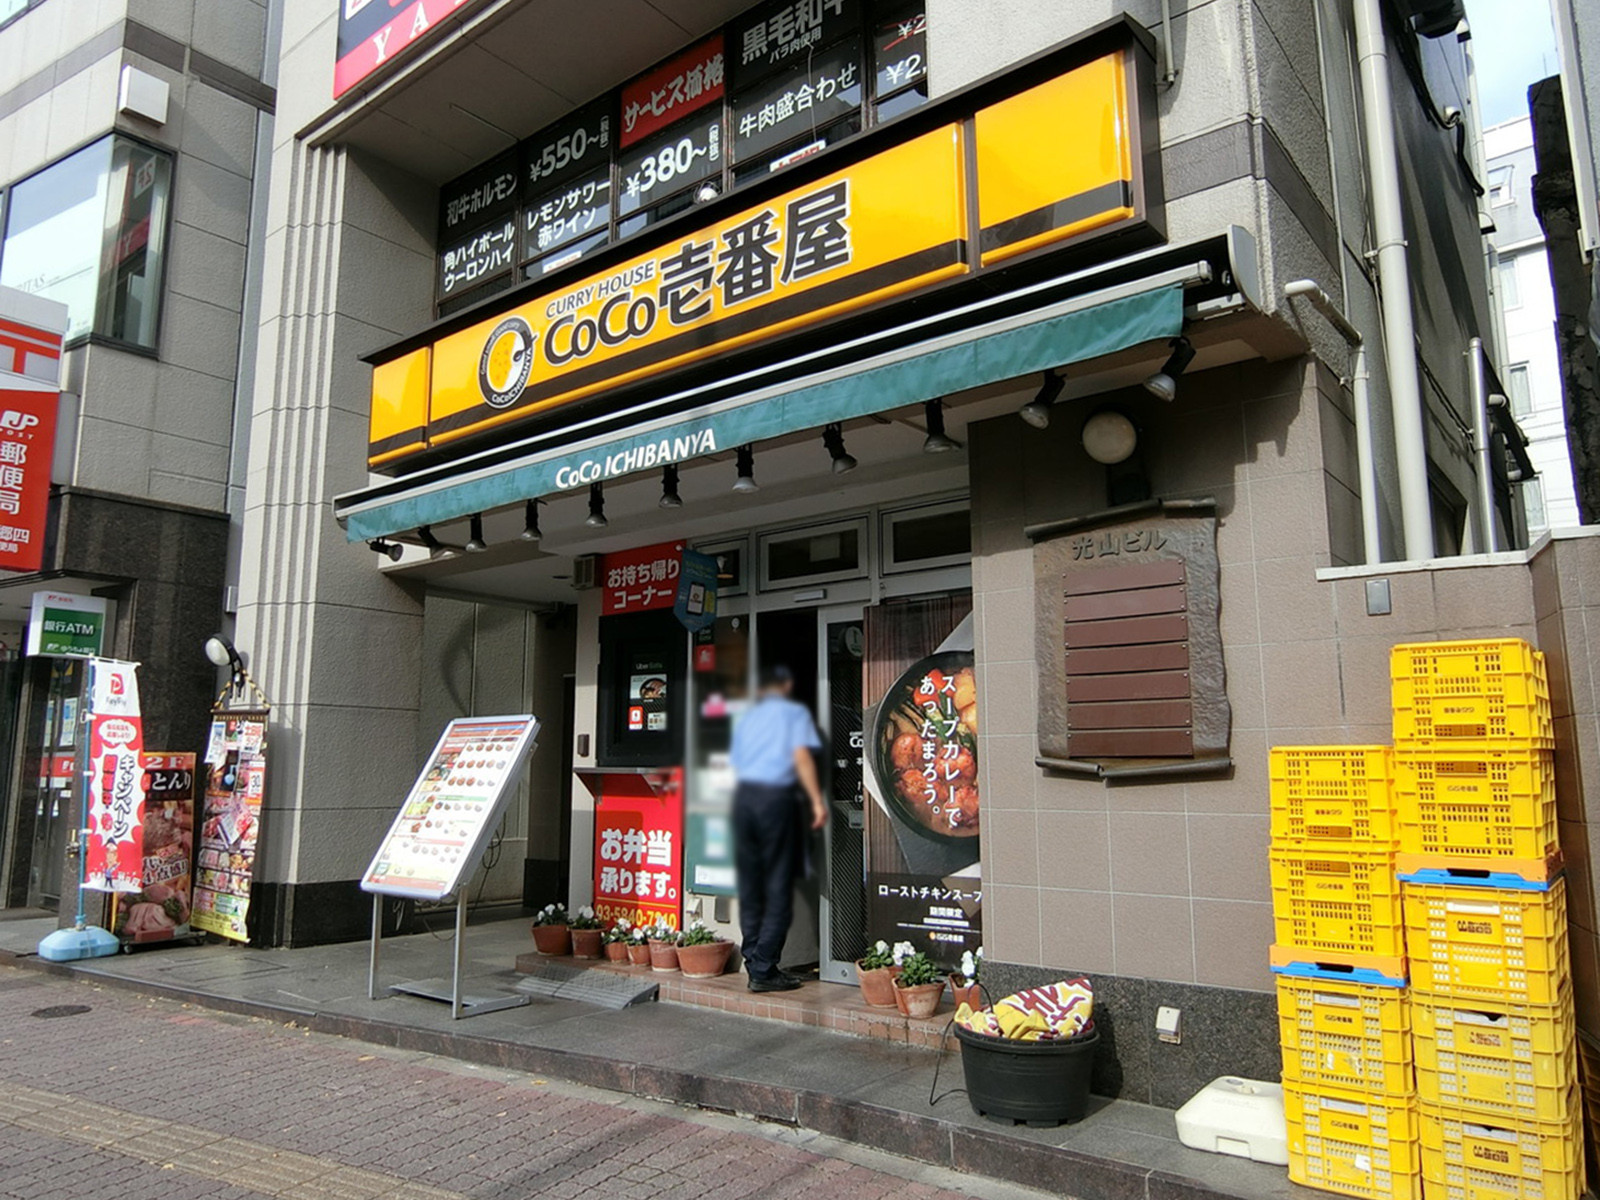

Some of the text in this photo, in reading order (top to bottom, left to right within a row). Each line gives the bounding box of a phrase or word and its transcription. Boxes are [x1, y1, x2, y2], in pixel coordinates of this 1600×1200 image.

[624, 52, 724, 133] サービス価格
[739, 63, 856, 138] 牛肉盛合わせ
[447, 171, 518, 227] 和牛ホルモン
[527, 179, 610, 231] レモンサワー
[444, 222, 515, 272] 角ハイボール
[537, 208, 597, 248] 赤ワイン
[444, 242, 515, 292] ウーロンハイ
[546, 279, 594, 318] CURRY
[598, 259, 655, 301] HOUSE
[0, 441, 27, 516] 郵便局
[555, 428, 717, 489] CoCo ICHIBANYA
[1072, 529, 1168, 561] 光山ビル
[607, 558, 680, 588] お持ち帰り
[613, 585, 672, 609] コーナー
[44, 620, 94, 635] 銀行ATM
[919, 676, 941, 814] あったまろう。
[941, 675, 962, 828] スープカレーで
[112, 754, 135, 839] キャンペーン
[600, 828, 673, 867] お弁当
[600, 866, 677, 899] 承ります。
